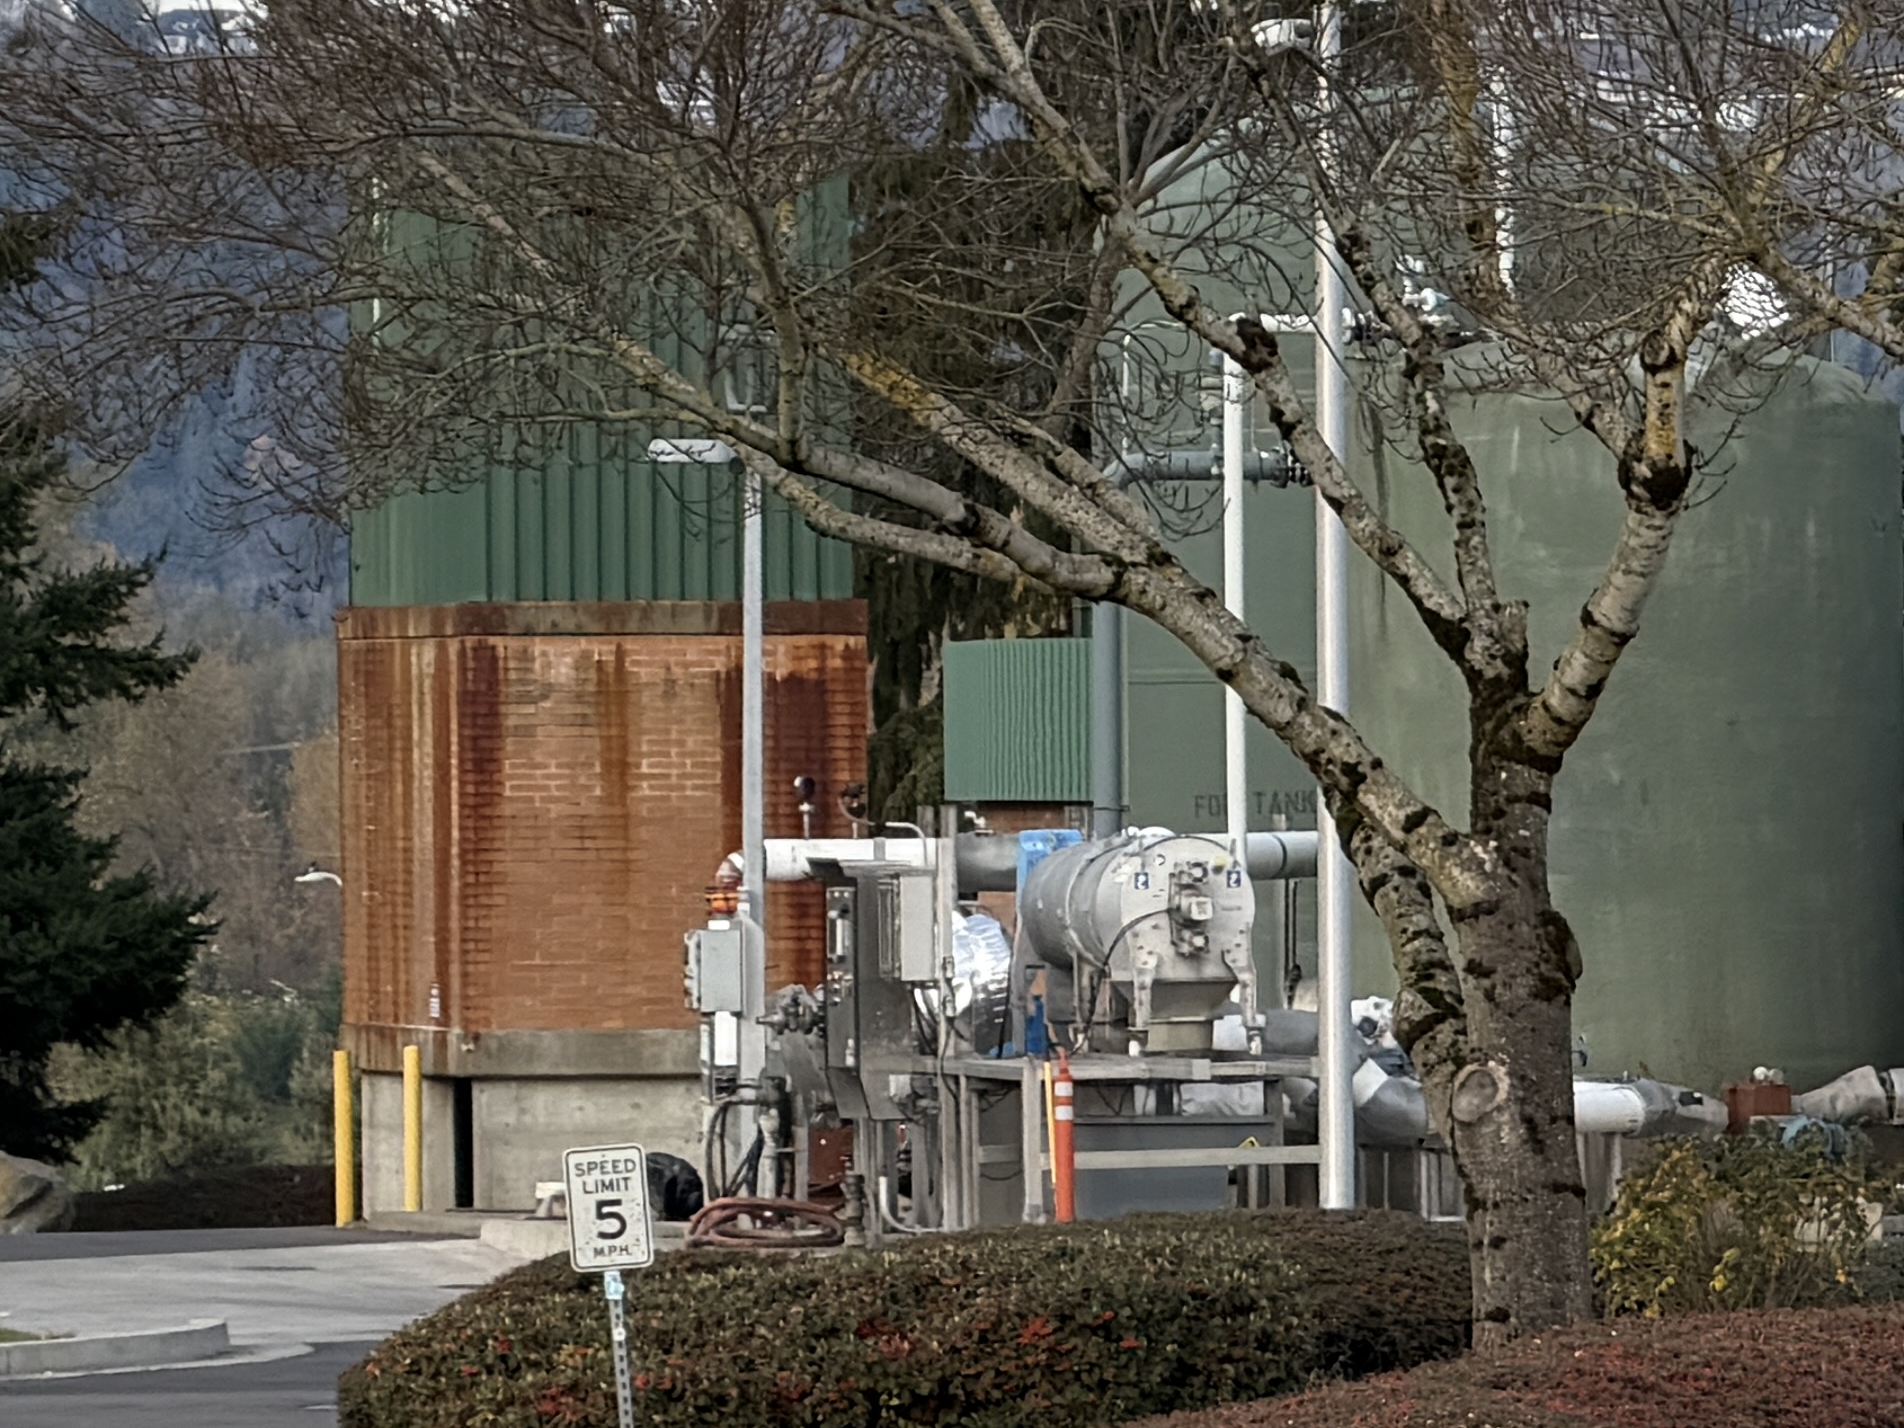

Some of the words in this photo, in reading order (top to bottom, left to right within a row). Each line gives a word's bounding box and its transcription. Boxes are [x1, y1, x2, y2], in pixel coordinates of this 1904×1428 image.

[1194, 794, 1228, 819] FO
[574, 1158, 637, 1177] SPEED
[582, 1177, 631, 1194] LIMIT
[595, 1198, 627, 1240] 5
